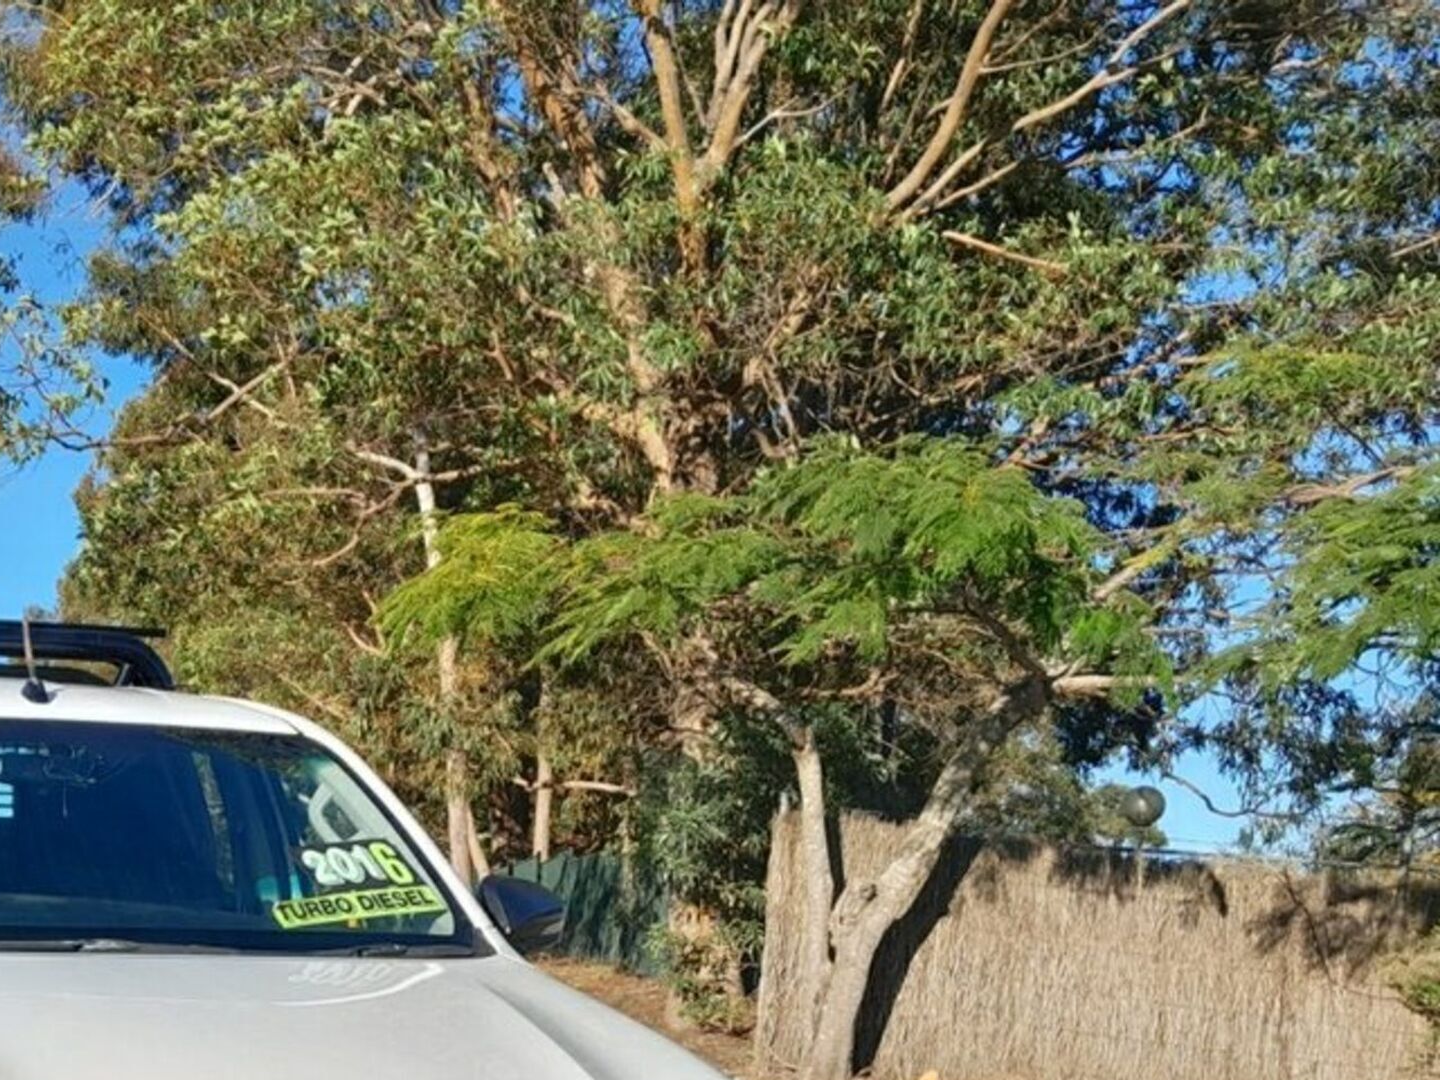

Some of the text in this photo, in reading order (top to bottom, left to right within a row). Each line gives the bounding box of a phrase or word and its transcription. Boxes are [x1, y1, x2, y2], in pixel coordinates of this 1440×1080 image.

[301, 841, 414, 885] 2016
[277, 889, 436, 921] TURBO DIESEL
